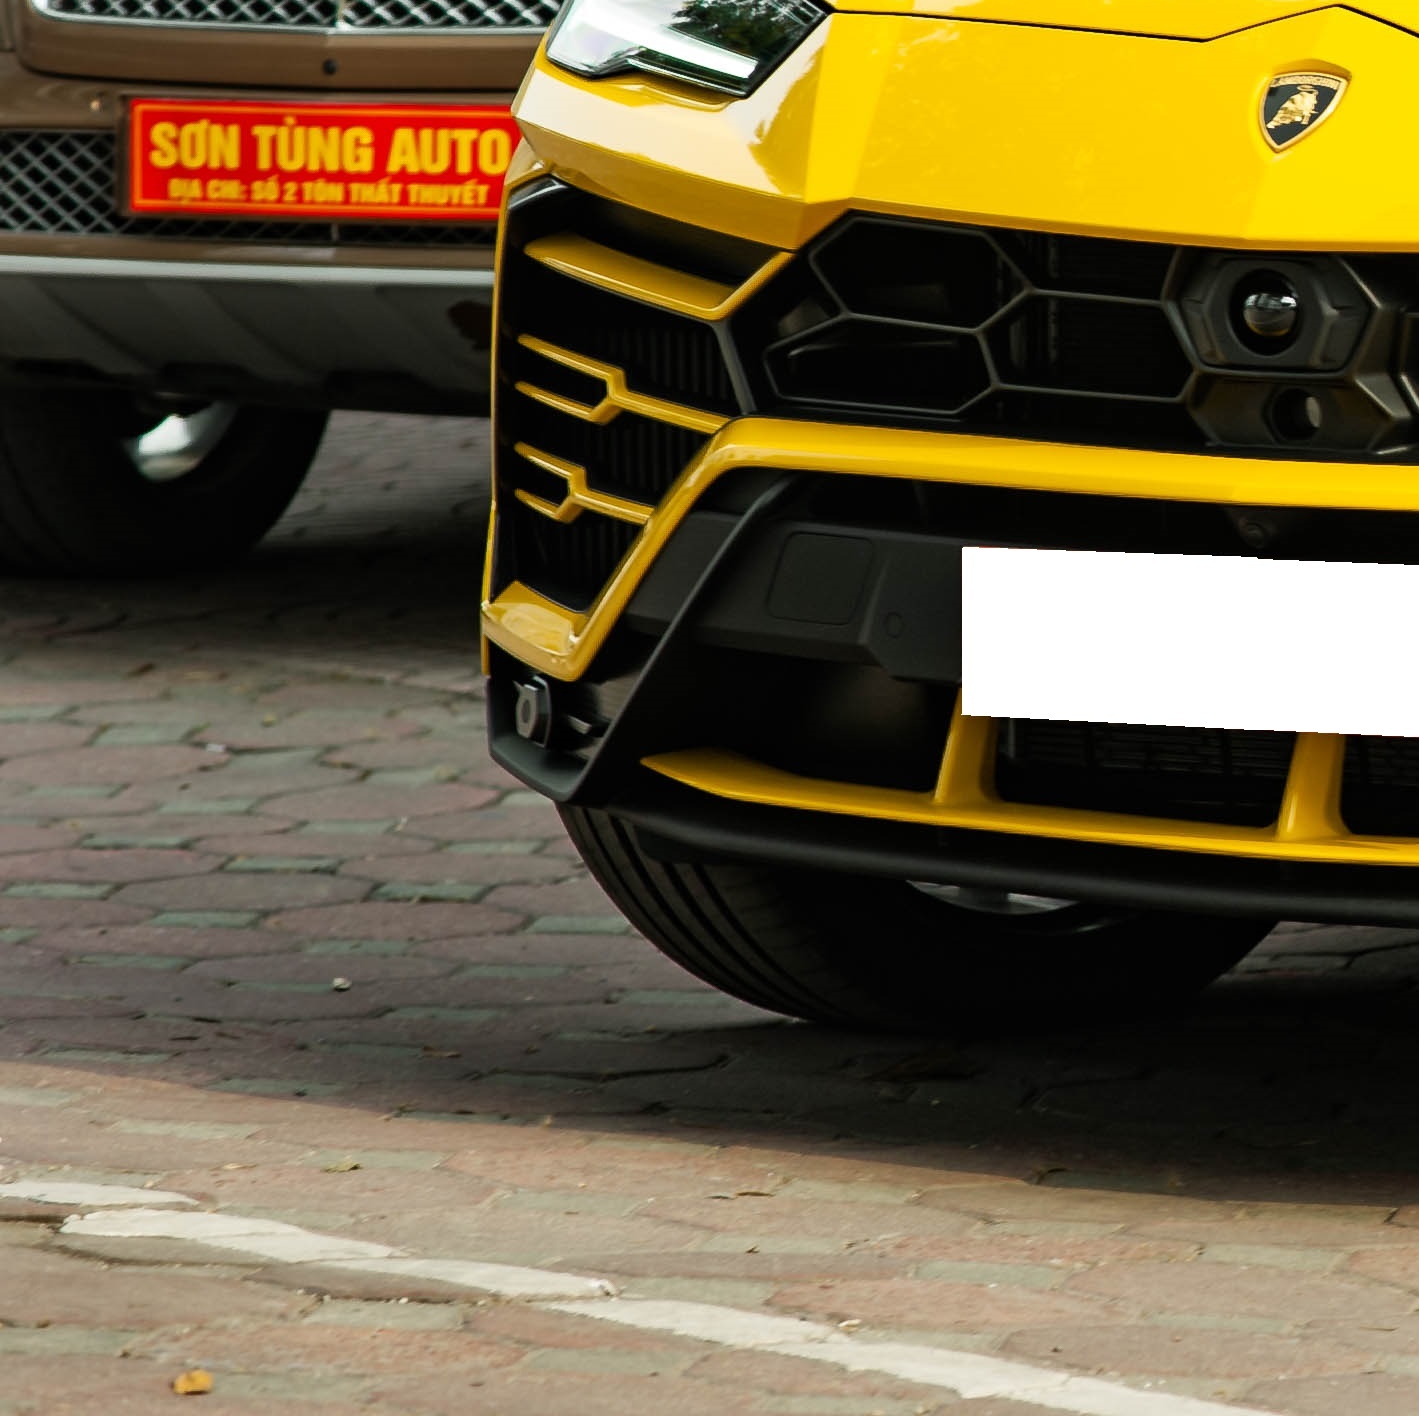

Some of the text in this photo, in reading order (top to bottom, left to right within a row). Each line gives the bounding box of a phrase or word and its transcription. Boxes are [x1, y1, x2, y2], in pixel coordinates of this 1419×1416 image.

[150, 119, 240, 169] SƠN
[385, 127, 511, 176] AUTO
[283, 181, 299, 202] 2
